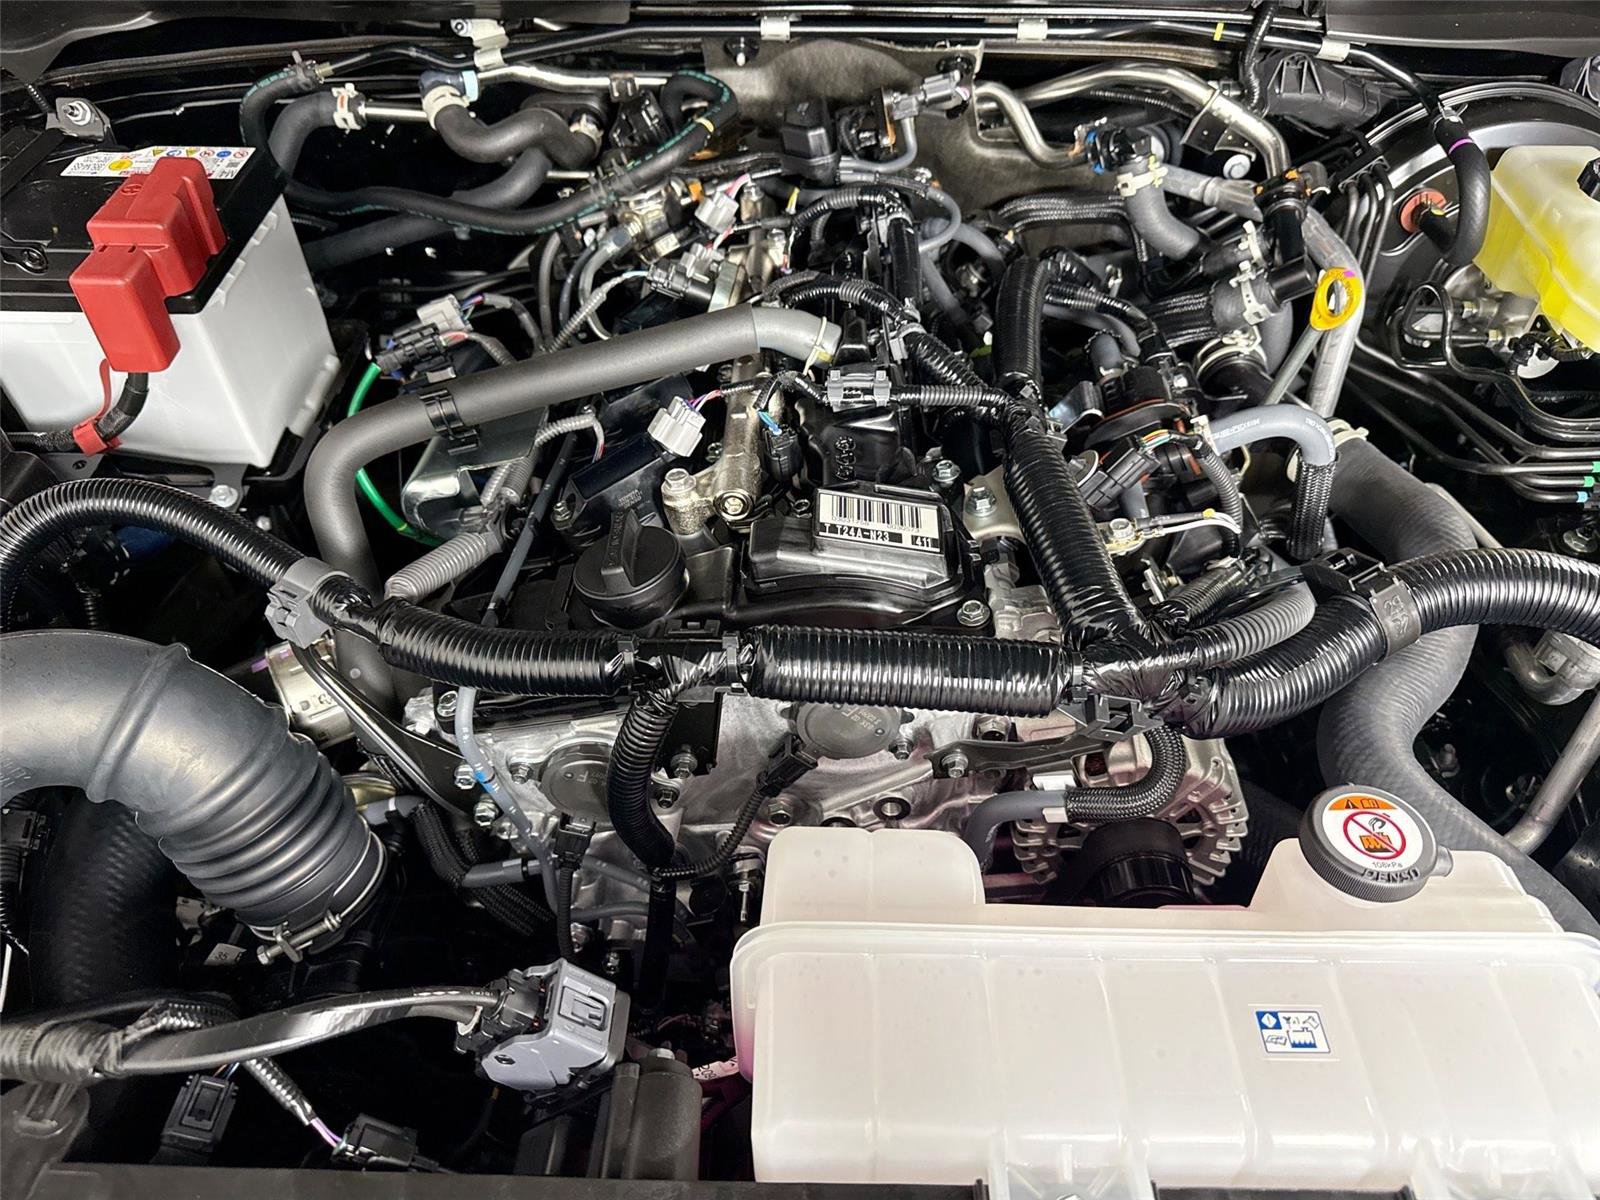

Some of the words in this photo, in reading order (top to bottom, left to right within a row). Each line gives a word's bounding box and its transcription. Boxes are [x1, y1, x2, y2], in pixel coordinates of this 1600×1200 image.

[824, 522, 831, 534] T
[836, 525, 890, 541] T24A-N23
[915, 538, 932, 548] 411
[1361, 866, 1420, 883] DENSO
